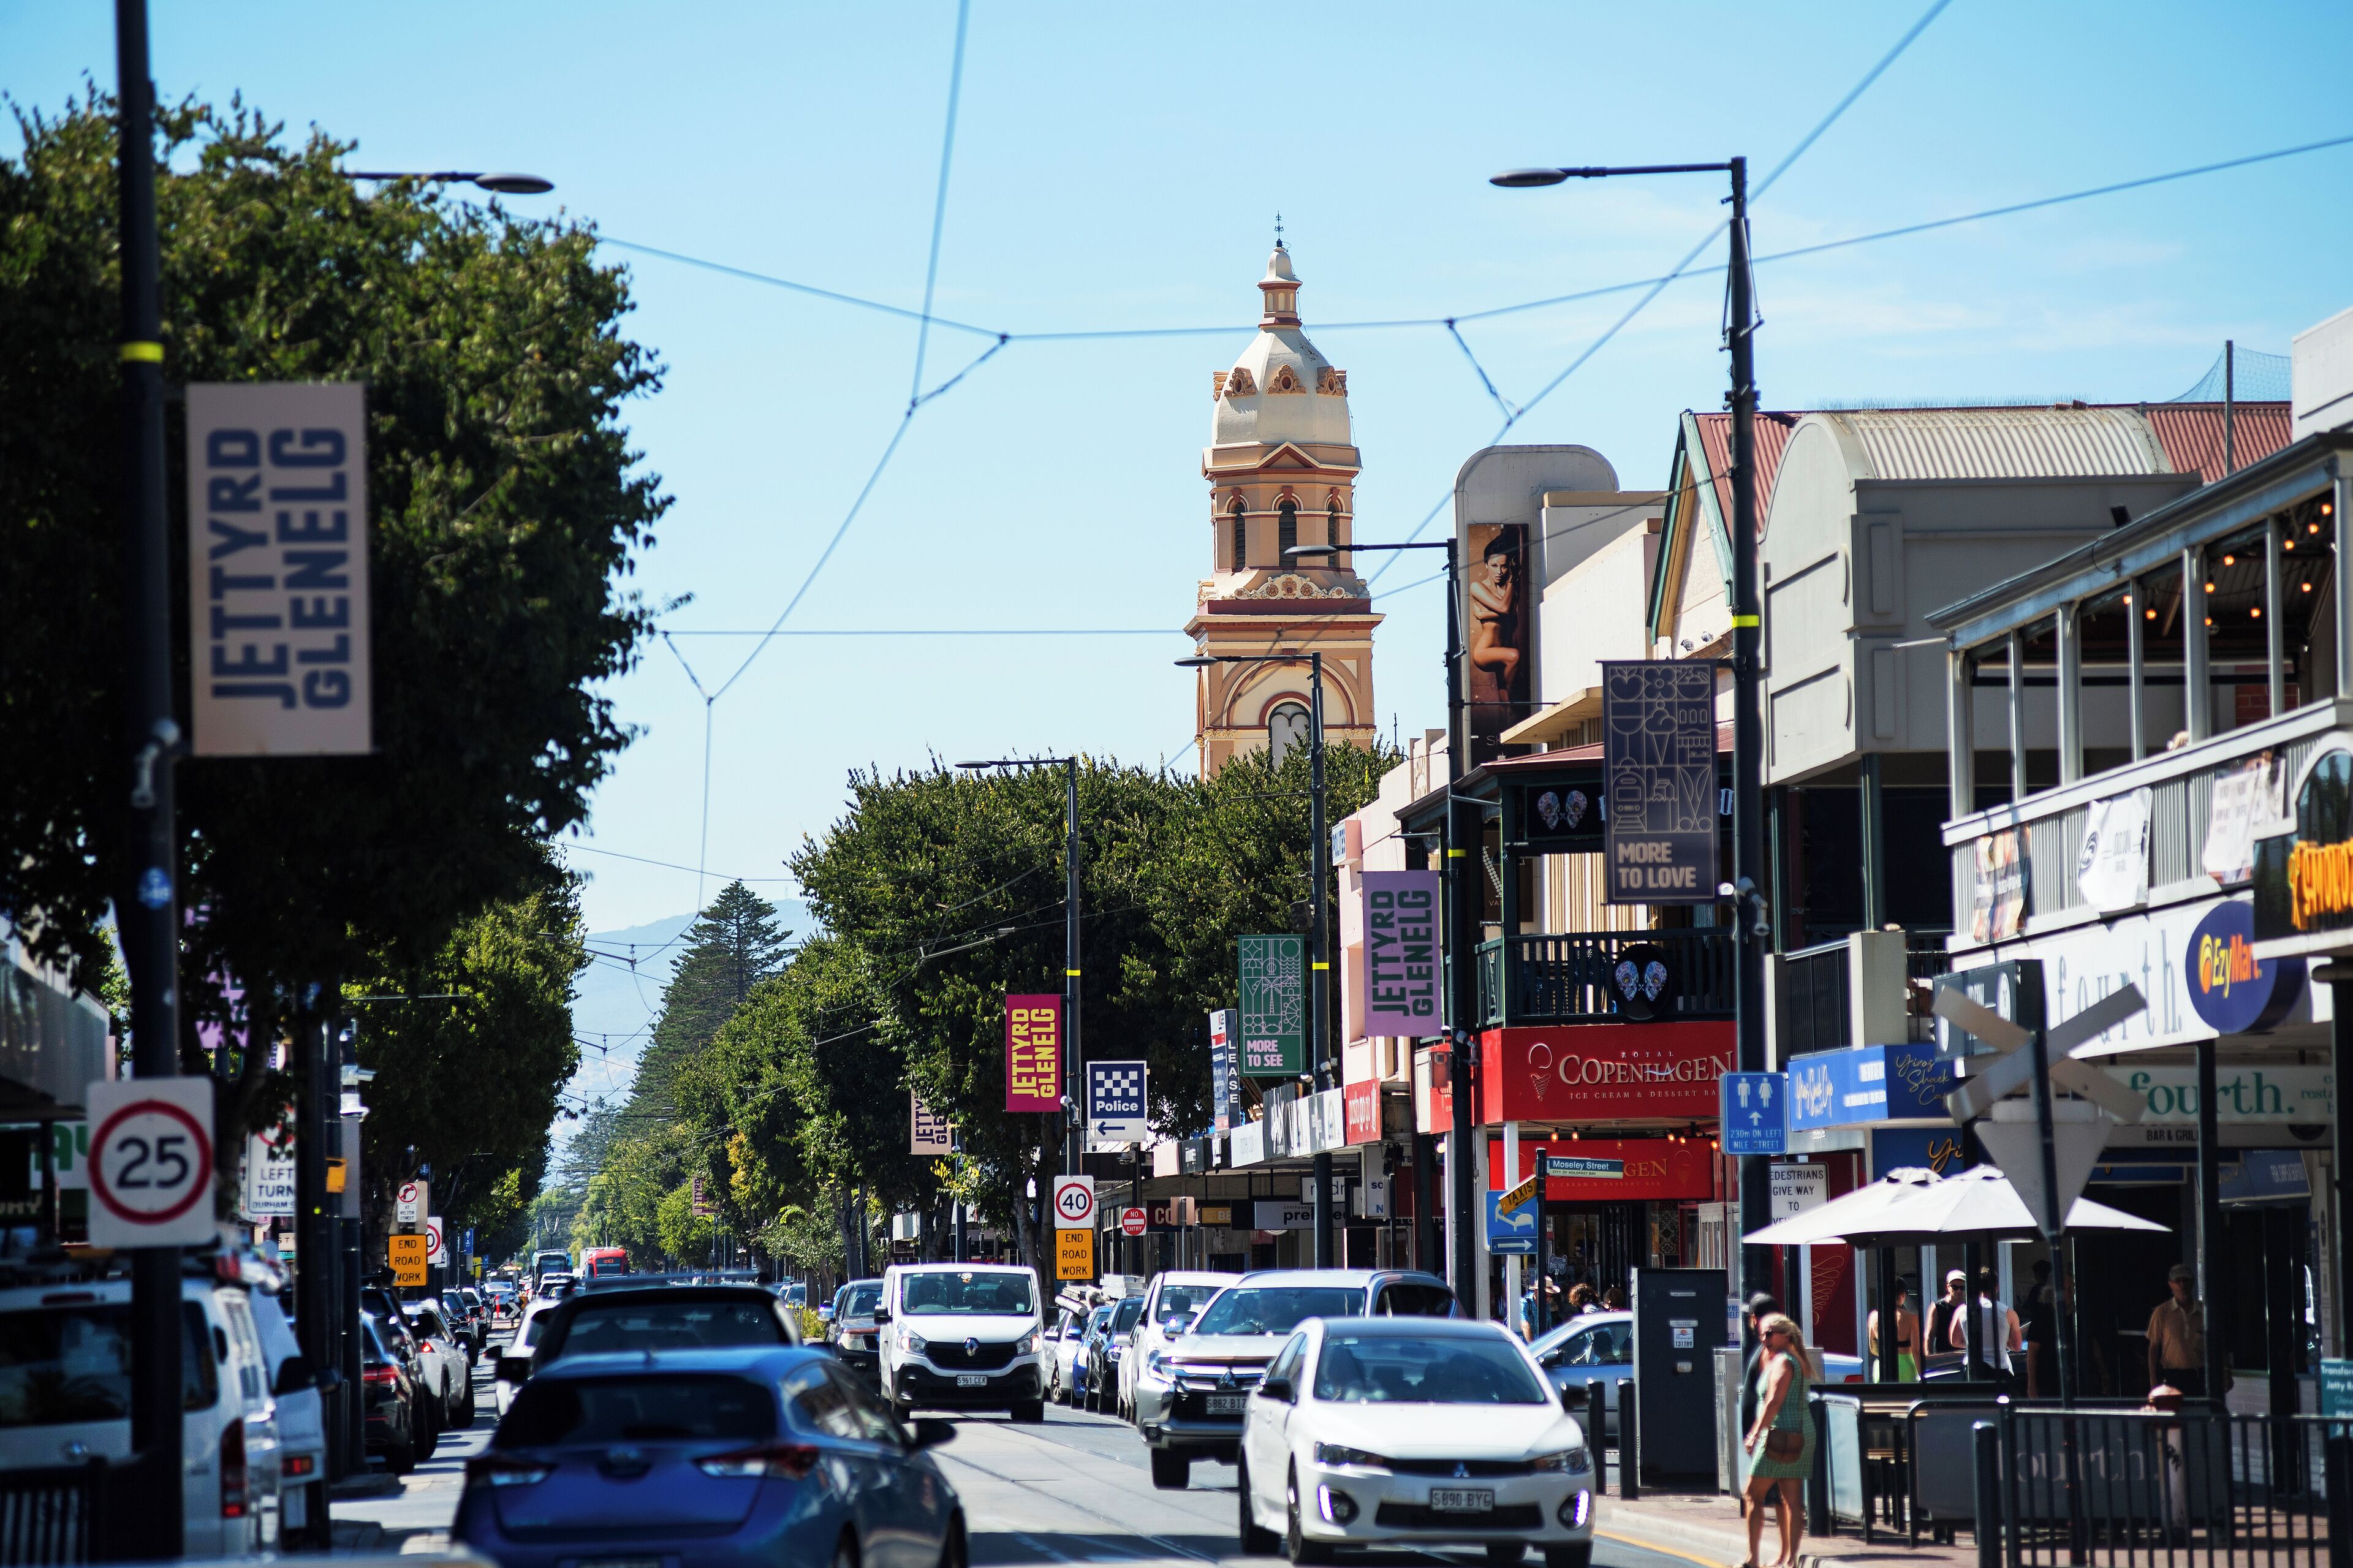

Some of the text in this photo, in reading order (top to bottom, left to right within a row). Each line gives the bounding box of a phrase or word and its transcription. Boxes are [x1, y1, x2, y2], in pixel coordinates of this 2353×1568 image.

[207, 428, 298, 710] JETTYRD
[268, 428, 352, 710] GLENELG
[1618, 841, 1672, 864] MORE
[1618, 866, 1697, 888] TO LOVE
[1370, 890, 1409, 1017] JETTYRD
[1397, 890, 1434, 1017] GLENELG
[1012, 1009, 1039, 1097] JETTYRD
[1031, 1008, 1056, 1098] GLENELG
[1246, 1040, 1278, 1053] MORE
[1247, 1055, 1283, 1067] TO SEE
[1559, 1050, 1733, 1085] COPENHAGEN
[1896, 1054, 1936, 1078] Yiros
[1227, 1040, 1239, 1104] LEASE
[1906, 1069, 1950, 1093] Shack
[1650, 1089, 1697, 1098] DESSERT
[1096, 1100, 1139, 1112] Police
[915, 1100, 935, 1145] JETTY
[1731, 1129, 1782, 1138] 230m ON LEFT
[2147, 1130, 2165, 1141] BAR
[1733, 1140, 1779, 1149] NILE STREET
[116, 1135, 190, 1190] 25
[1553, 1160, 1609, 1170] Moseley Street
[1771, 1170, 1824, 1181] EDESTRIANS
[1506, 1181, 1534, 1206] TAXIS
[1773, 1186, 1815, 1196] GIVE WAY
[1062, 1193, 1088, 1210] 40
[1789, 1202, 1800, 1211] TO
[398, 1240, 417, 1249] END
[1066, 1234, 1083, 1243] END
[395, 1256, 420, 1265] ROAD
[1062, 1250, 1087, 1260] ROAD
[1062, 1266, 1088, 1276] WORK
